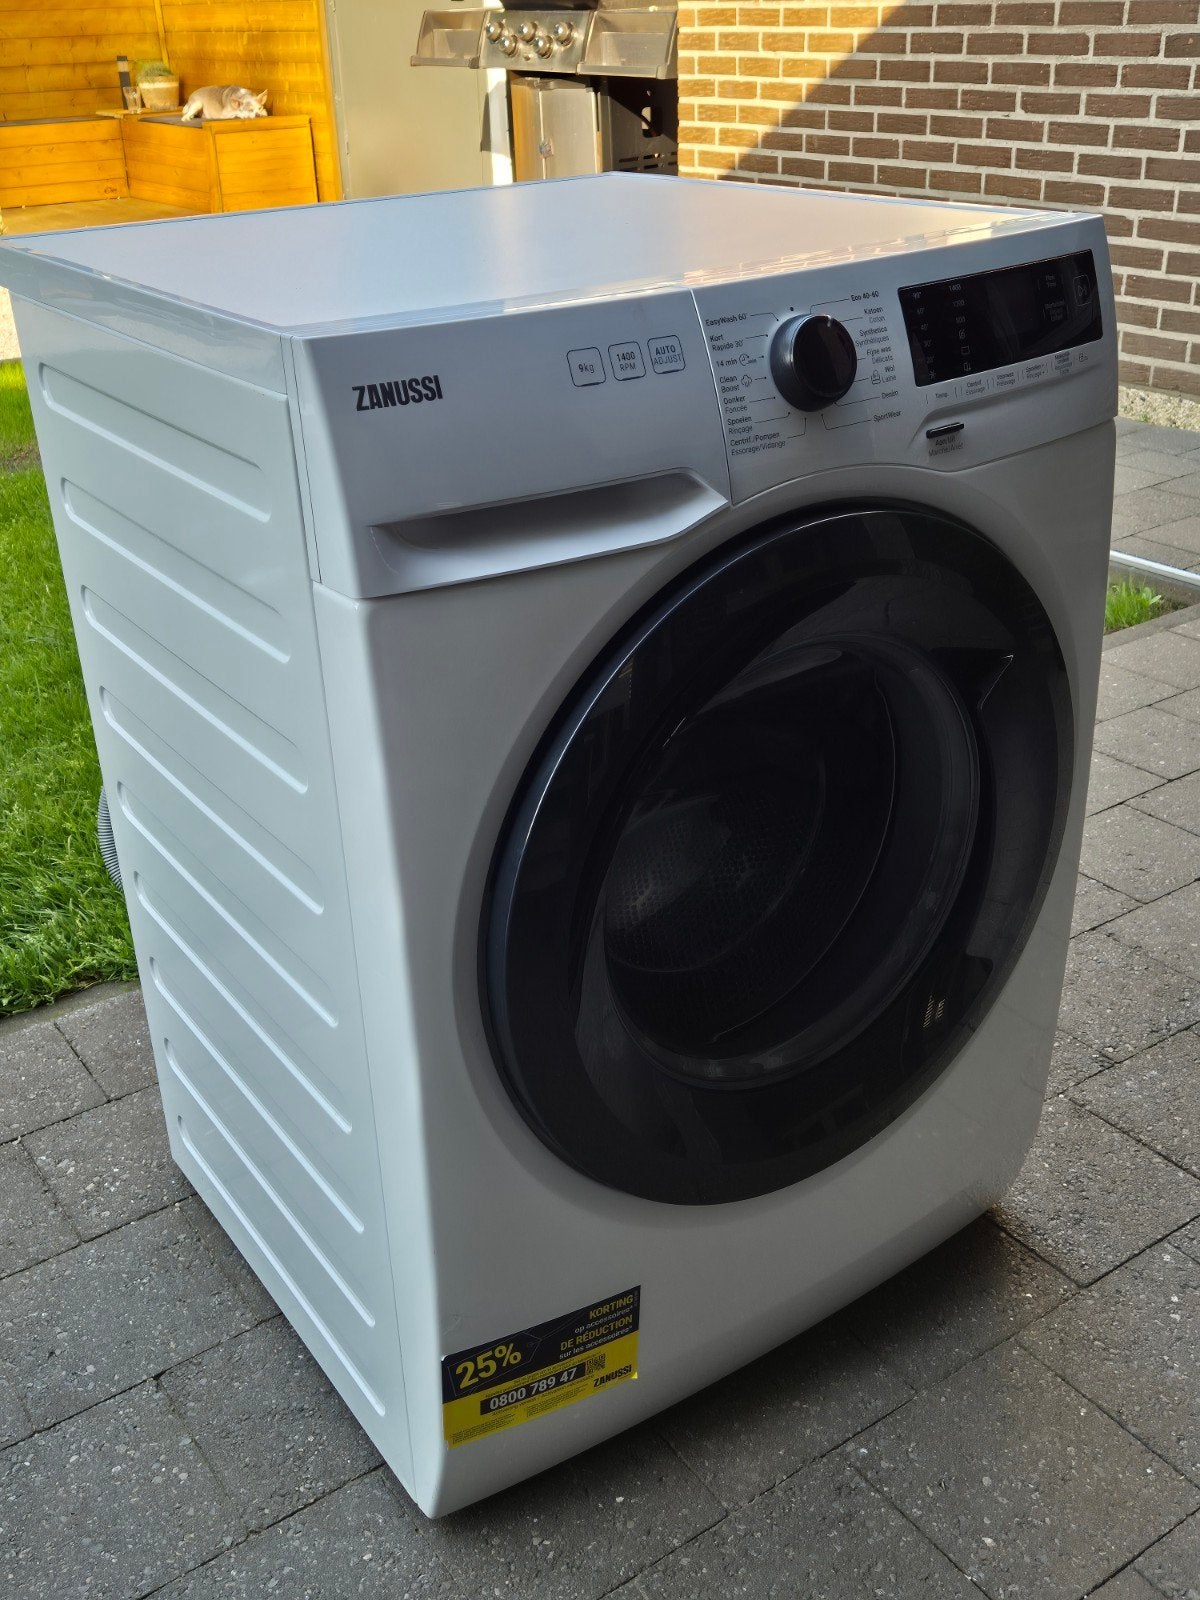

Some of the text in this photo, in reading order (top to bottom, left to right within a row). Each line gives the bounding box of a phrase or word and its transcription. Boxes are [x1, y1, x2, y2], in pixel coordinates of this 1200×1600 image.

[851, 294, 862, 302] Eco
[864, 306, 884, 315] Katoen
[705, 314, 738, 327] EasyWash
[710, 334, 724, 342] Kort
[655, 344, 676, 356] AUTO
[712, 341, 734, 351] Rapide
[616, 351, 636, 362] 1400
[653, 352, 682, 366] ADJUST
[725, 357, 738, 366] min
[577, 363, 595, 374] 9kg
[619, 361, 637, 372] RPM
[719, 375, 738, 384] Clean
[352, 374, 443, 412] ZANUSSI
[721, 384, 740, 394] Boost
[723, 395, 746, 405] Donker
[727, 416, 753, 426] Spoelen
[873, 410, 903, 423] SportWear
[728, 425, 753, 435] Rinçage
[588, 1294, 634, 1320] KORTING
[560, 1313, 633, 1352] DE RÉDUCTION
[574, 1325, 585, 1335] op
[559, 1350, 572, 1361] sur
[573, 1344, 585, 1355] les
[455, 1342, 522, 1390] 25%
[593, 1363, 633, 1389] ZANUSSI
[489, 1387, 527, 1411] 0800
[530, 1375, 557, 1396] 789
[559, 1366, 578, 1383] 47
